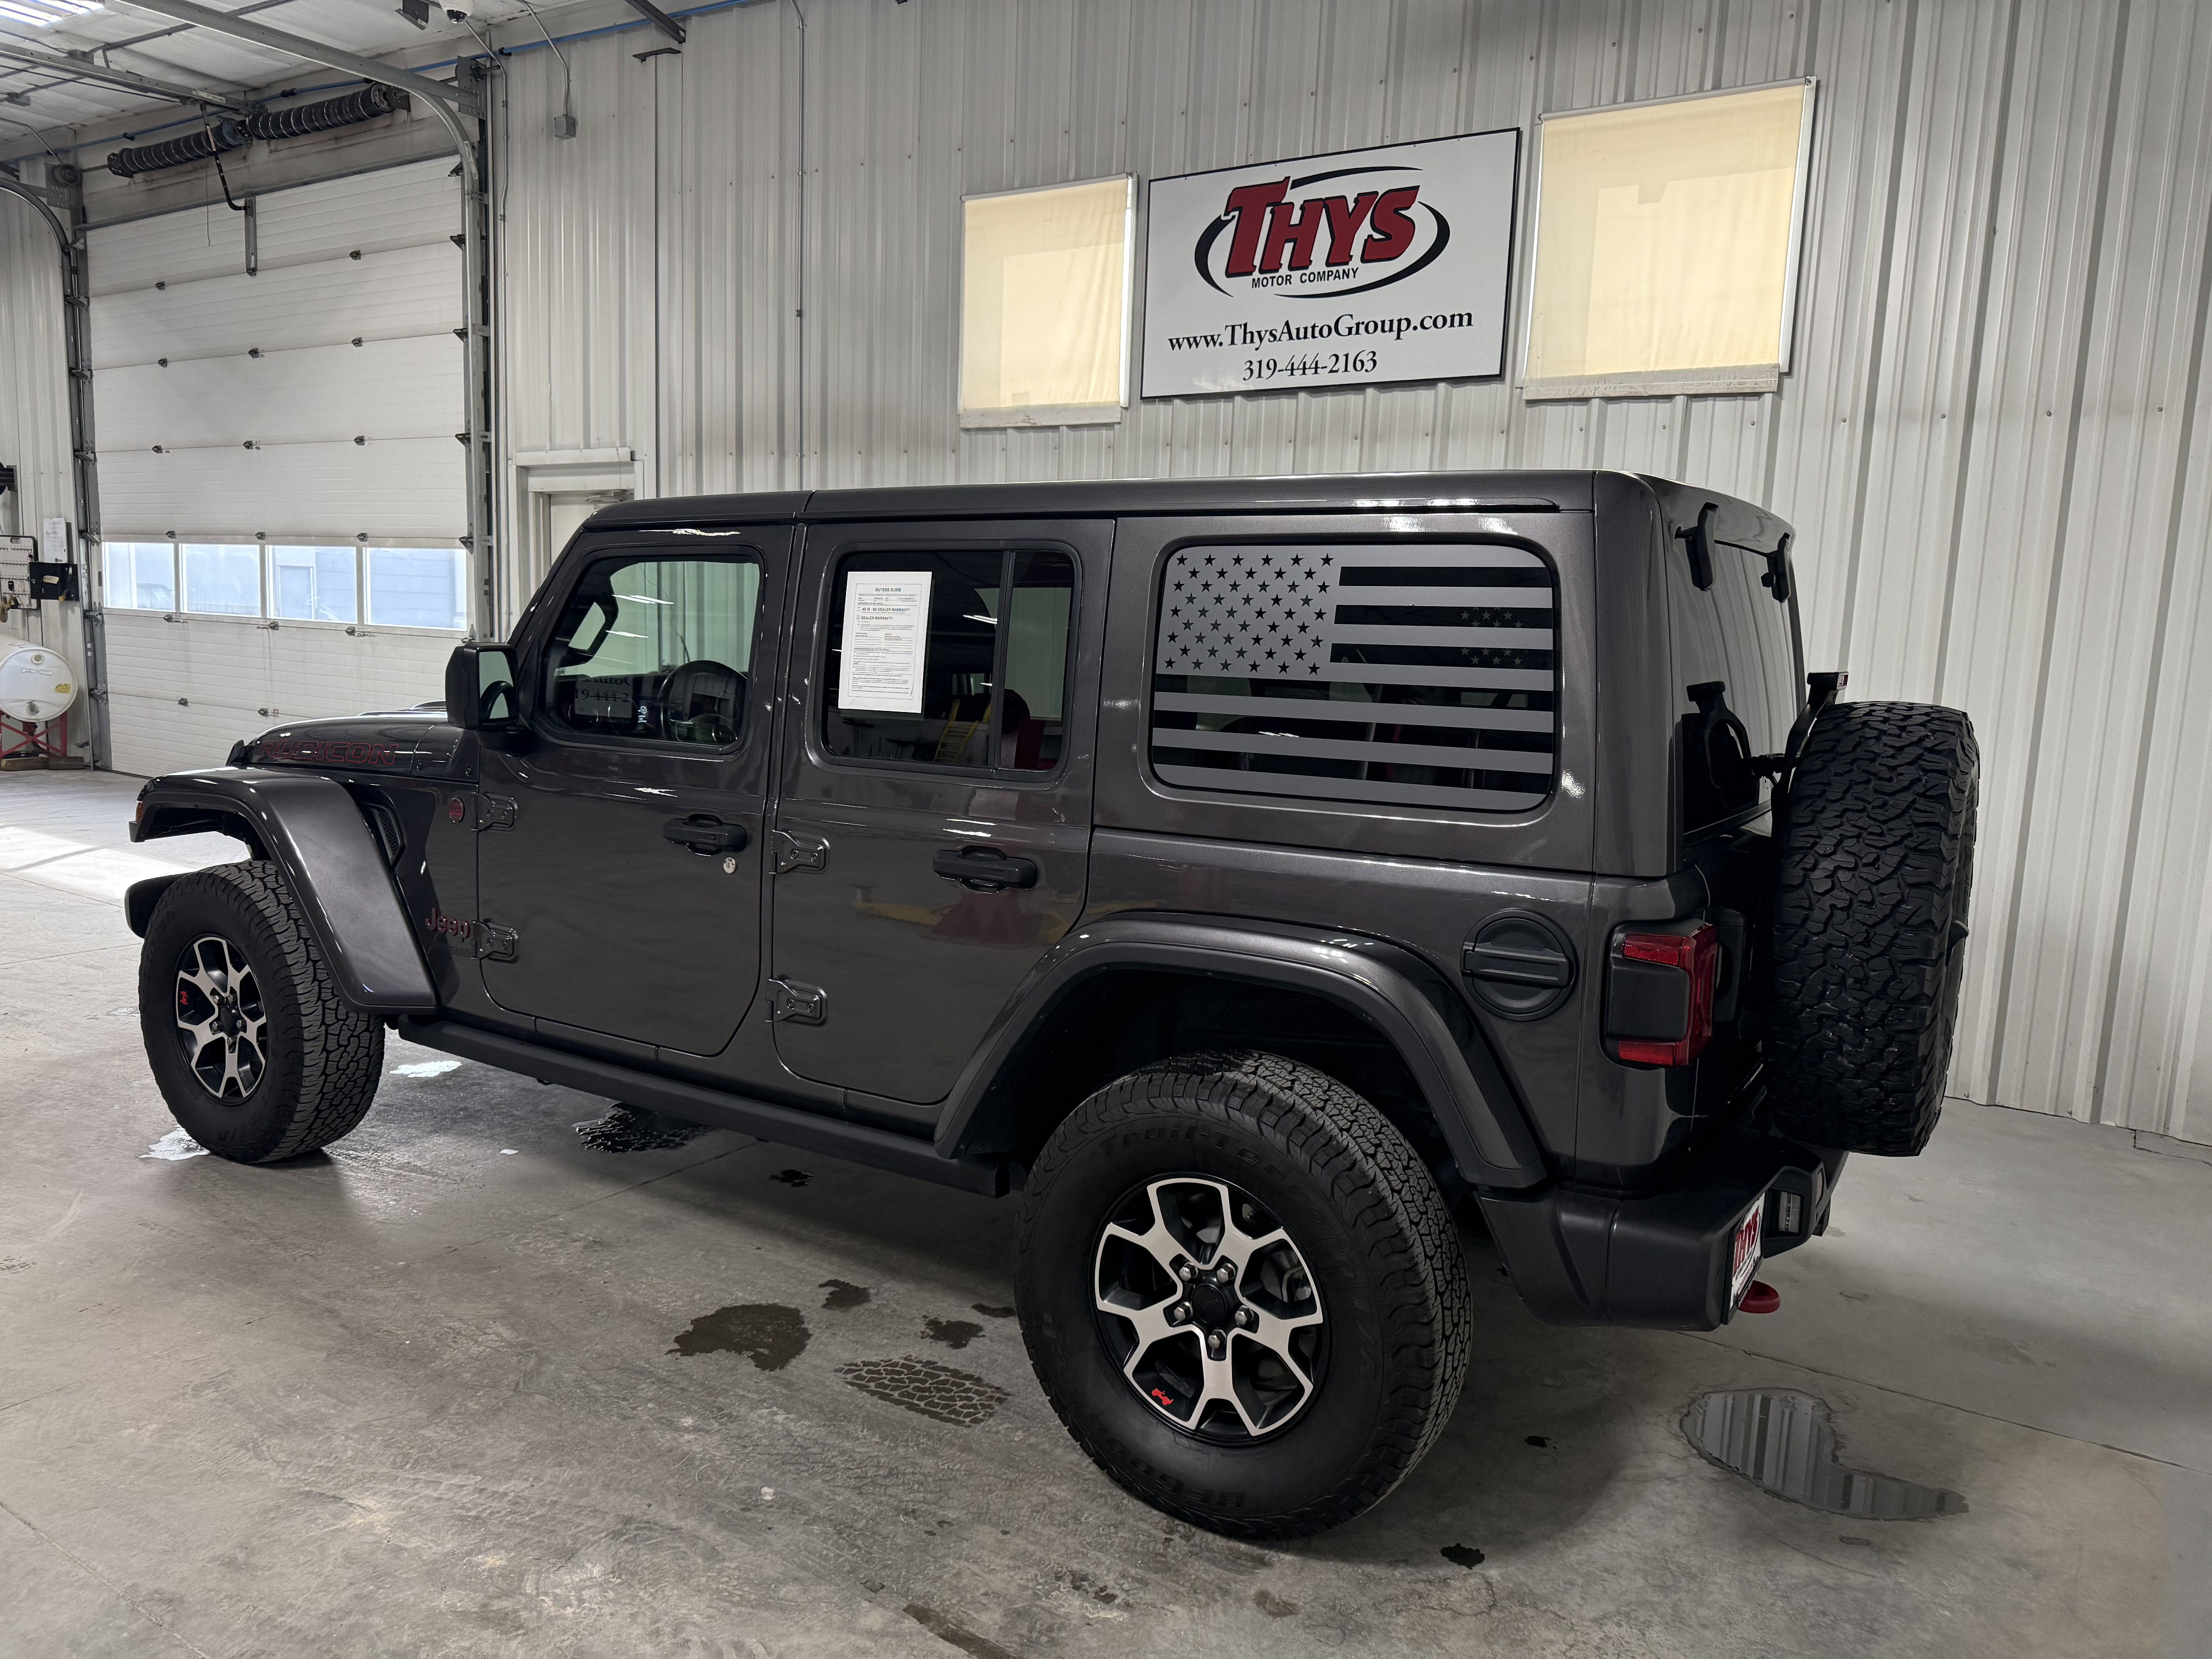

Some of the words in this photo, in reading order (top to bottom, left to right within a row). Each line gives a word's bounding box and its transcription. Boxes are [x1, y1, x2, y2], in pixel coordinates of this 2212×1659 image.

[1224, 176, 1420, 278] THYS
[1251, 274, 1292, 289] MOTOR
[1299, 267, 1359, 284] COMPANY
[1168, 312, 1474, 351] www.ThysAutoGroup.com
[1243, 350, 1377, 381] 319-444-2163
[257, 739, 399, 765] RUBICON
[425, 907, 470, 943] Jeep
